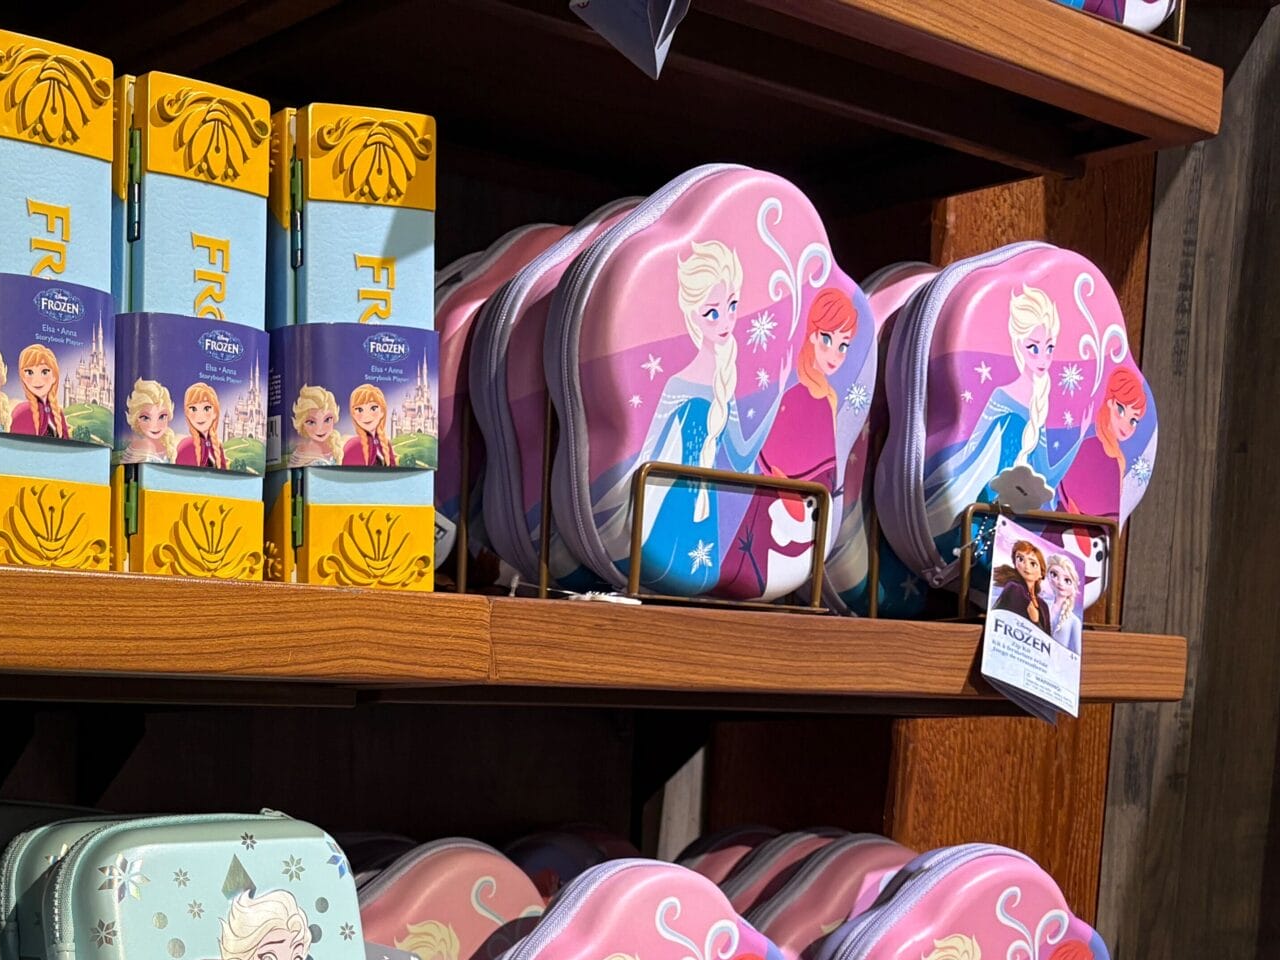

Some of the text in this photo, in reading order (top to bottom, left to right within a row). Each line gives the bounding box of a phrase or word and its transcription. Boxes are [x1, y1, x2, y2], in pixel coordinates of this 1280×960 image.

[26, 197, 71, 280] FR
[41, 298, 79, 314] FROZEN
[205, 338, 240, 354] FROZEN
[370, 341, 406, 354] FROZEN
[993, 618, 1052, 656] FROZEN
